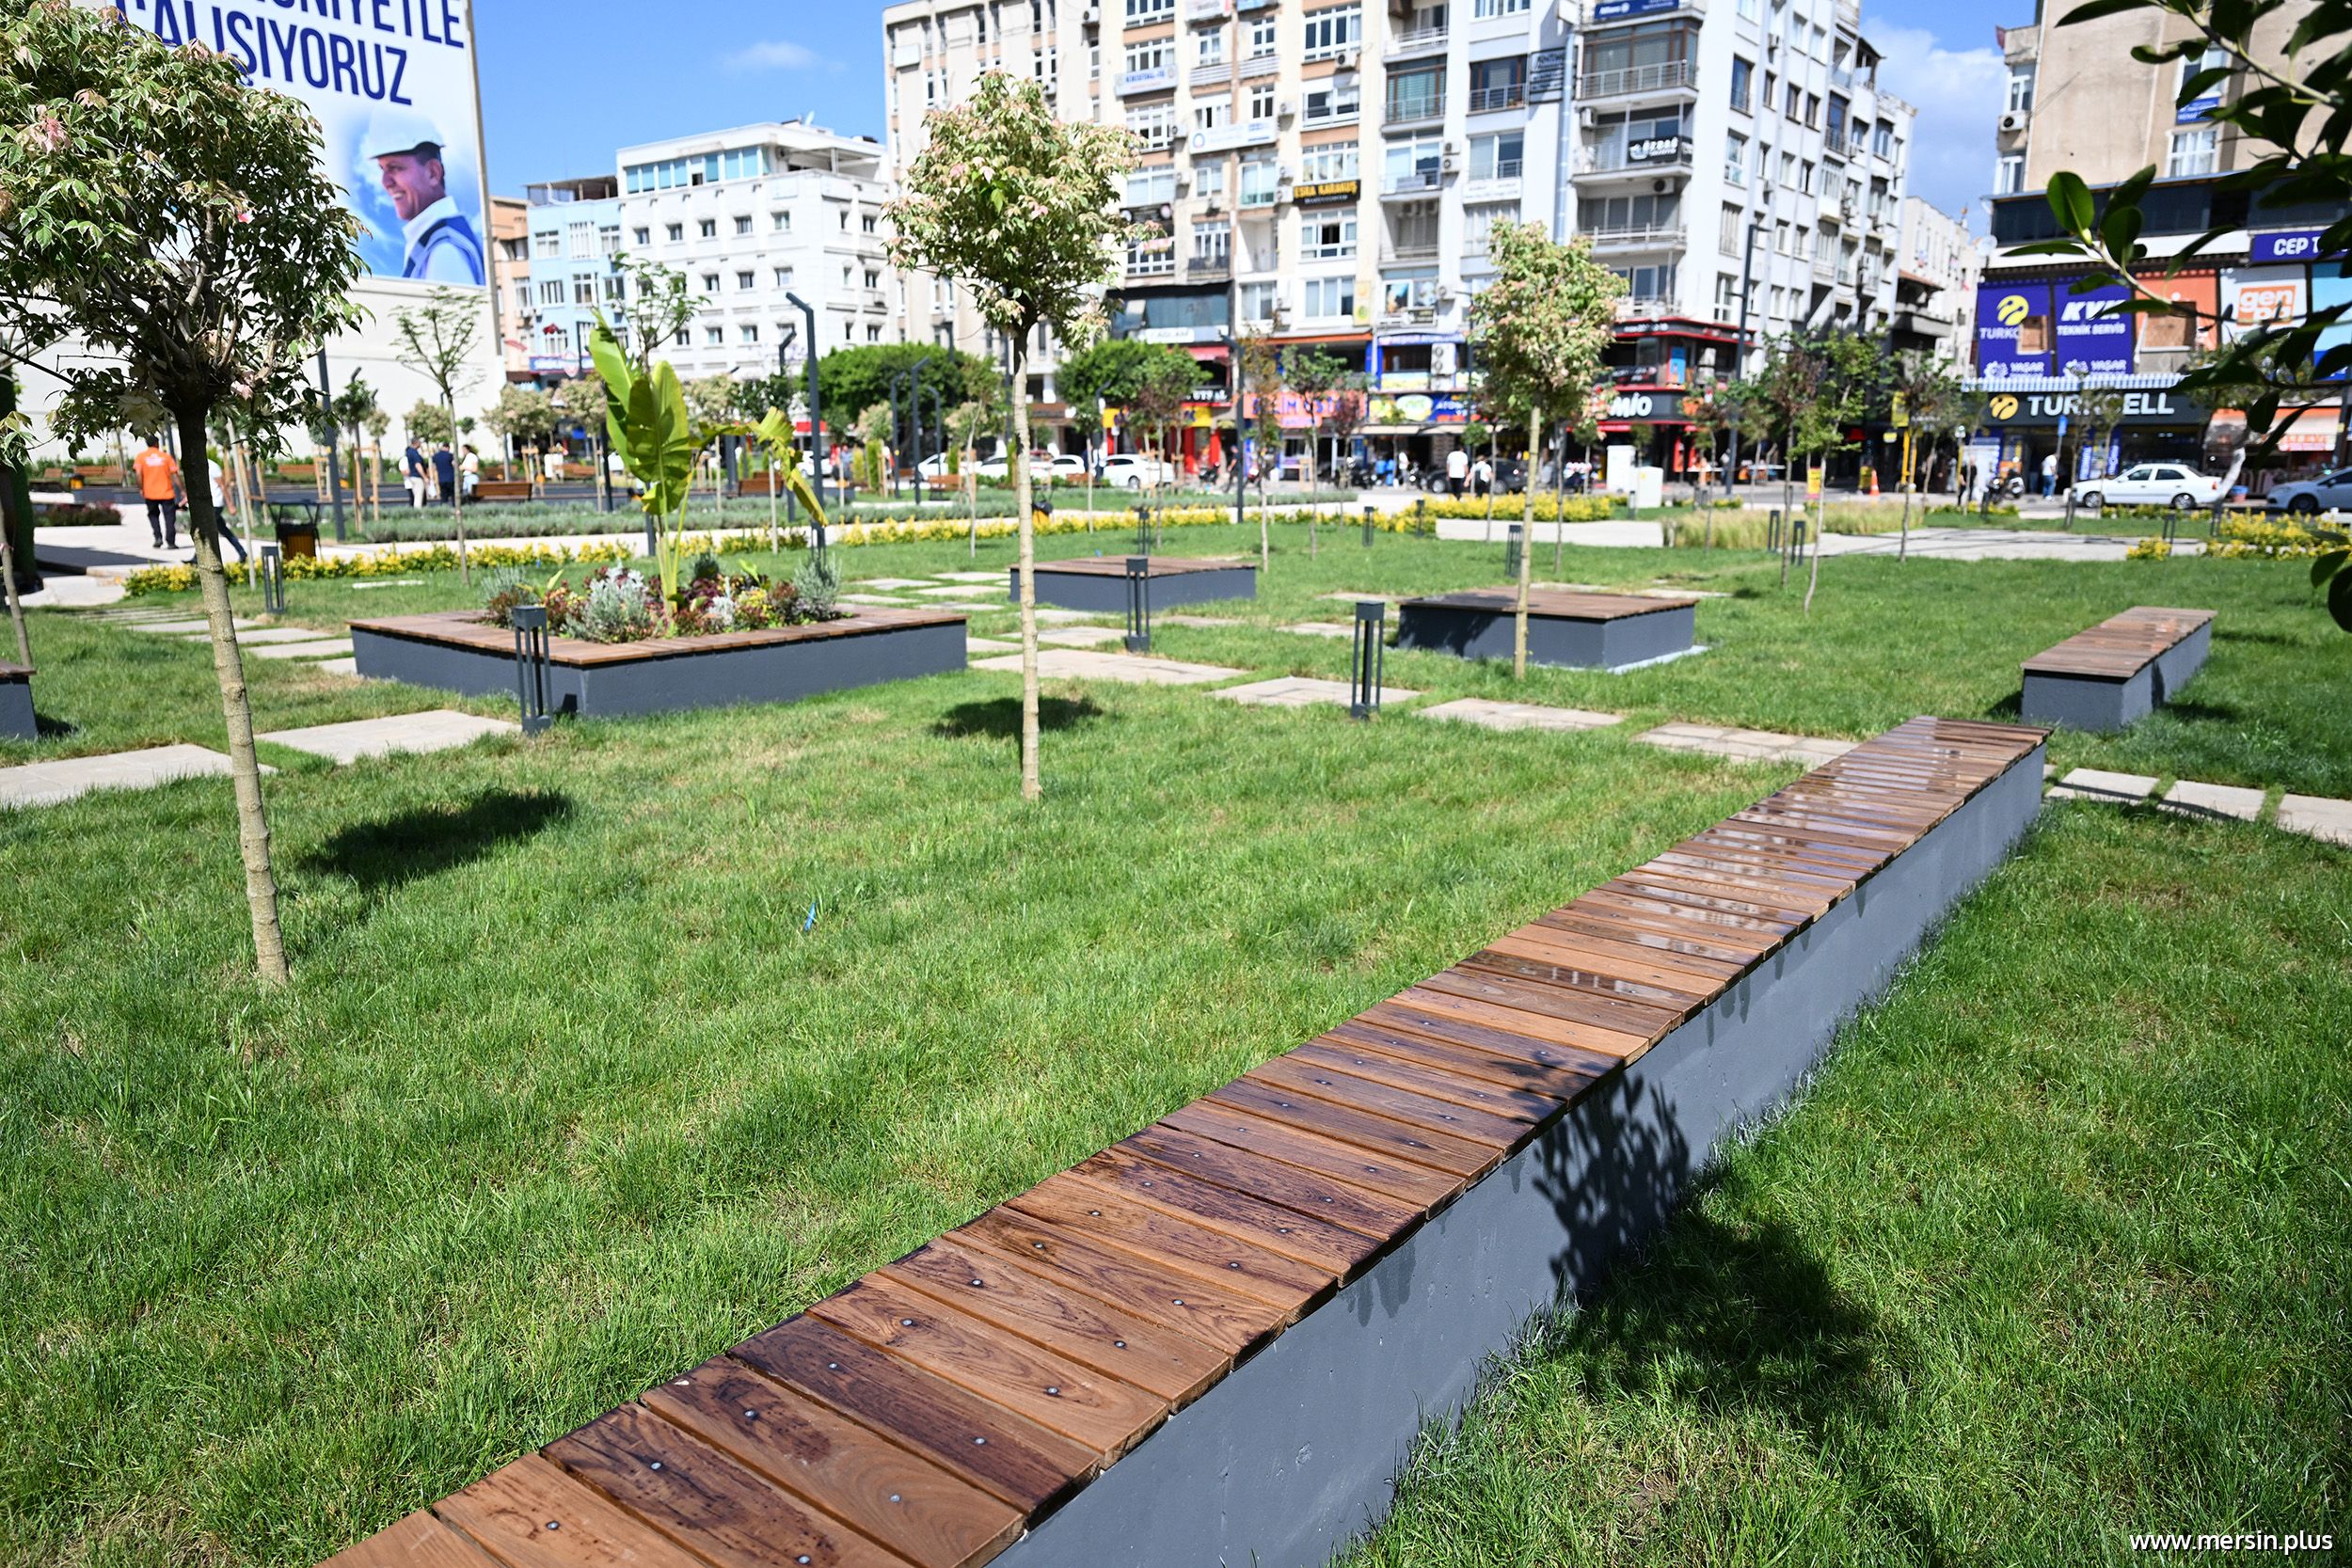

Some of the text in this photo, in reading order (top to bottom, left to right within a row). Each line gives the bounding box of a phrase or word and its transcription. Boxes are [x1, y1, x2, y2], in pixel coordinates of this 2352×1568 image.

[114, 0, 412, 105] ALIŞIYORUZ
[2274, 237, 2308, 256] CEP
[2240, 290, 2294, 312] gen
[2027, 392, 2174, 417] TURCELL
